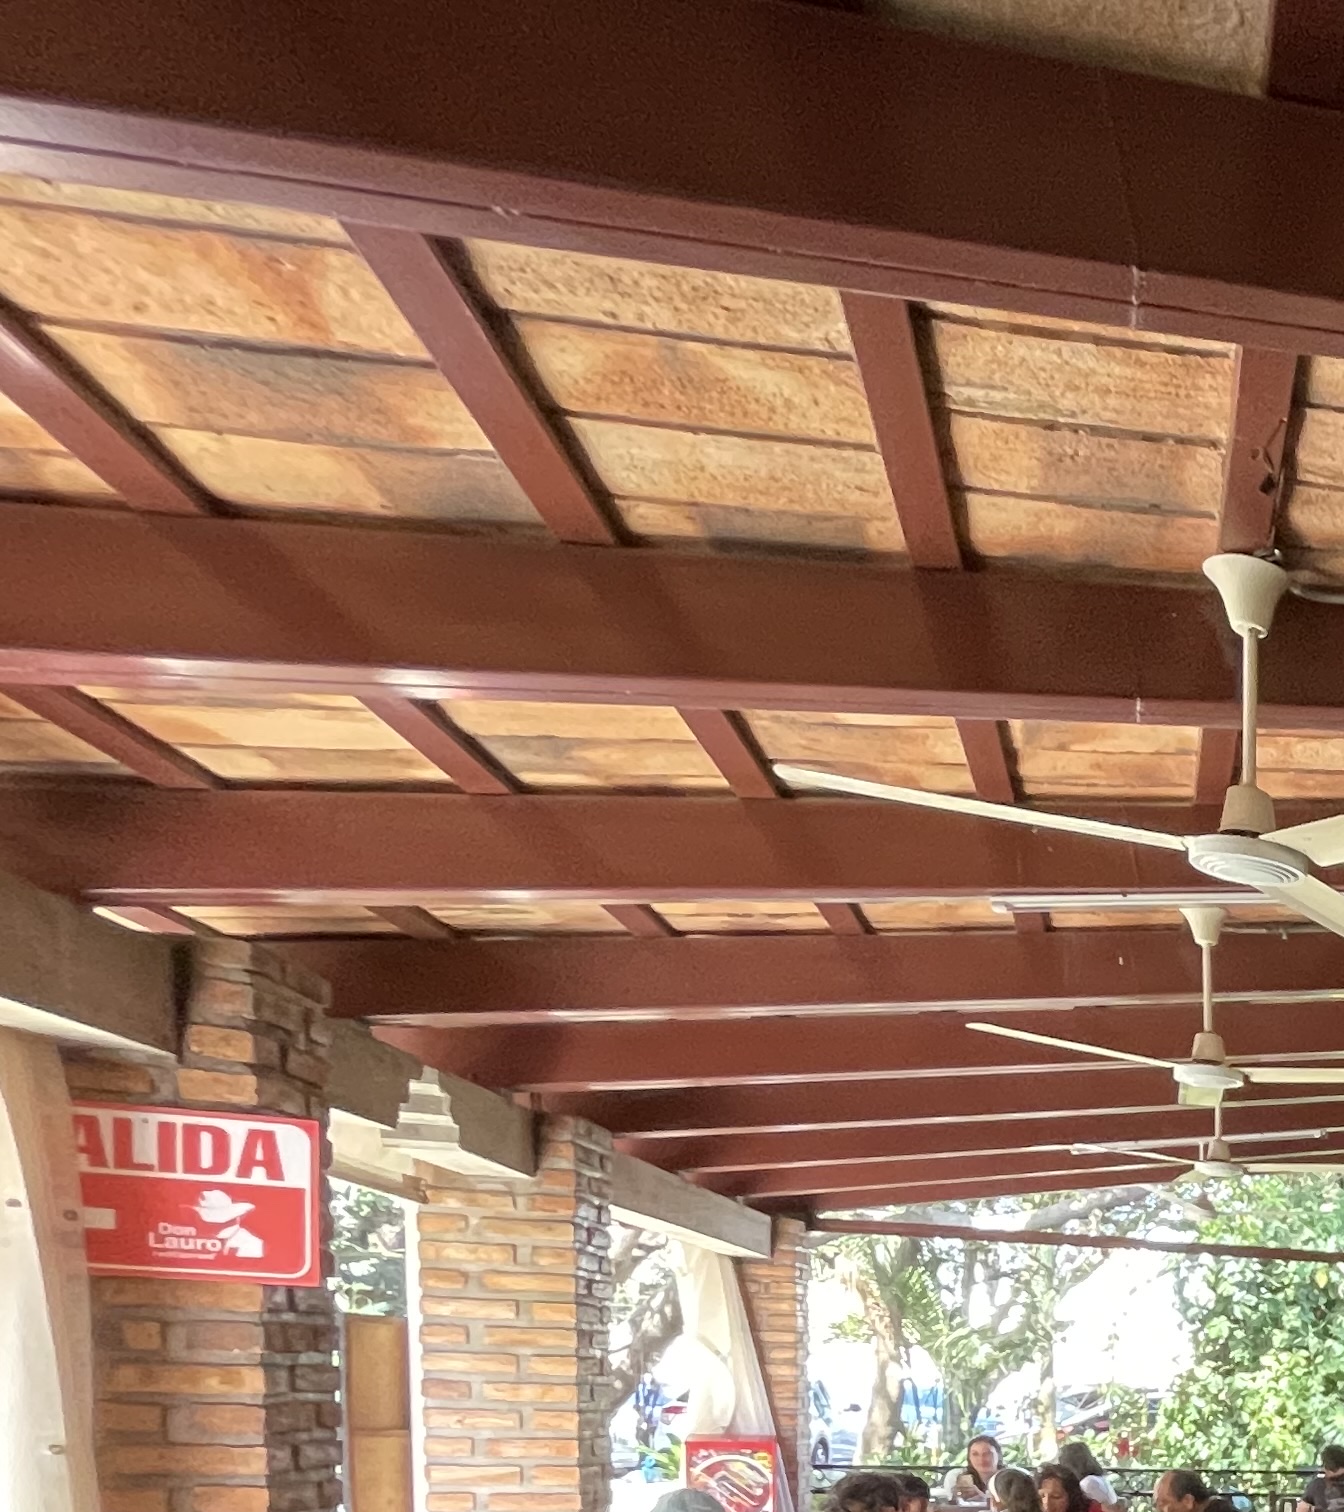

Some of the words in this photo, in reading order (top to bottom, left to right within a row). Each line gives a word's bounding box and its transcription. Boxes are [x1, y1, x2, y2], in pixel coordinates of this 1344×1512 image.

[71, 1114, 285, 1181] ALIDA
[157, 1221, 197, 1236] Don
[148, 1231, 222, 1252] Lauro
